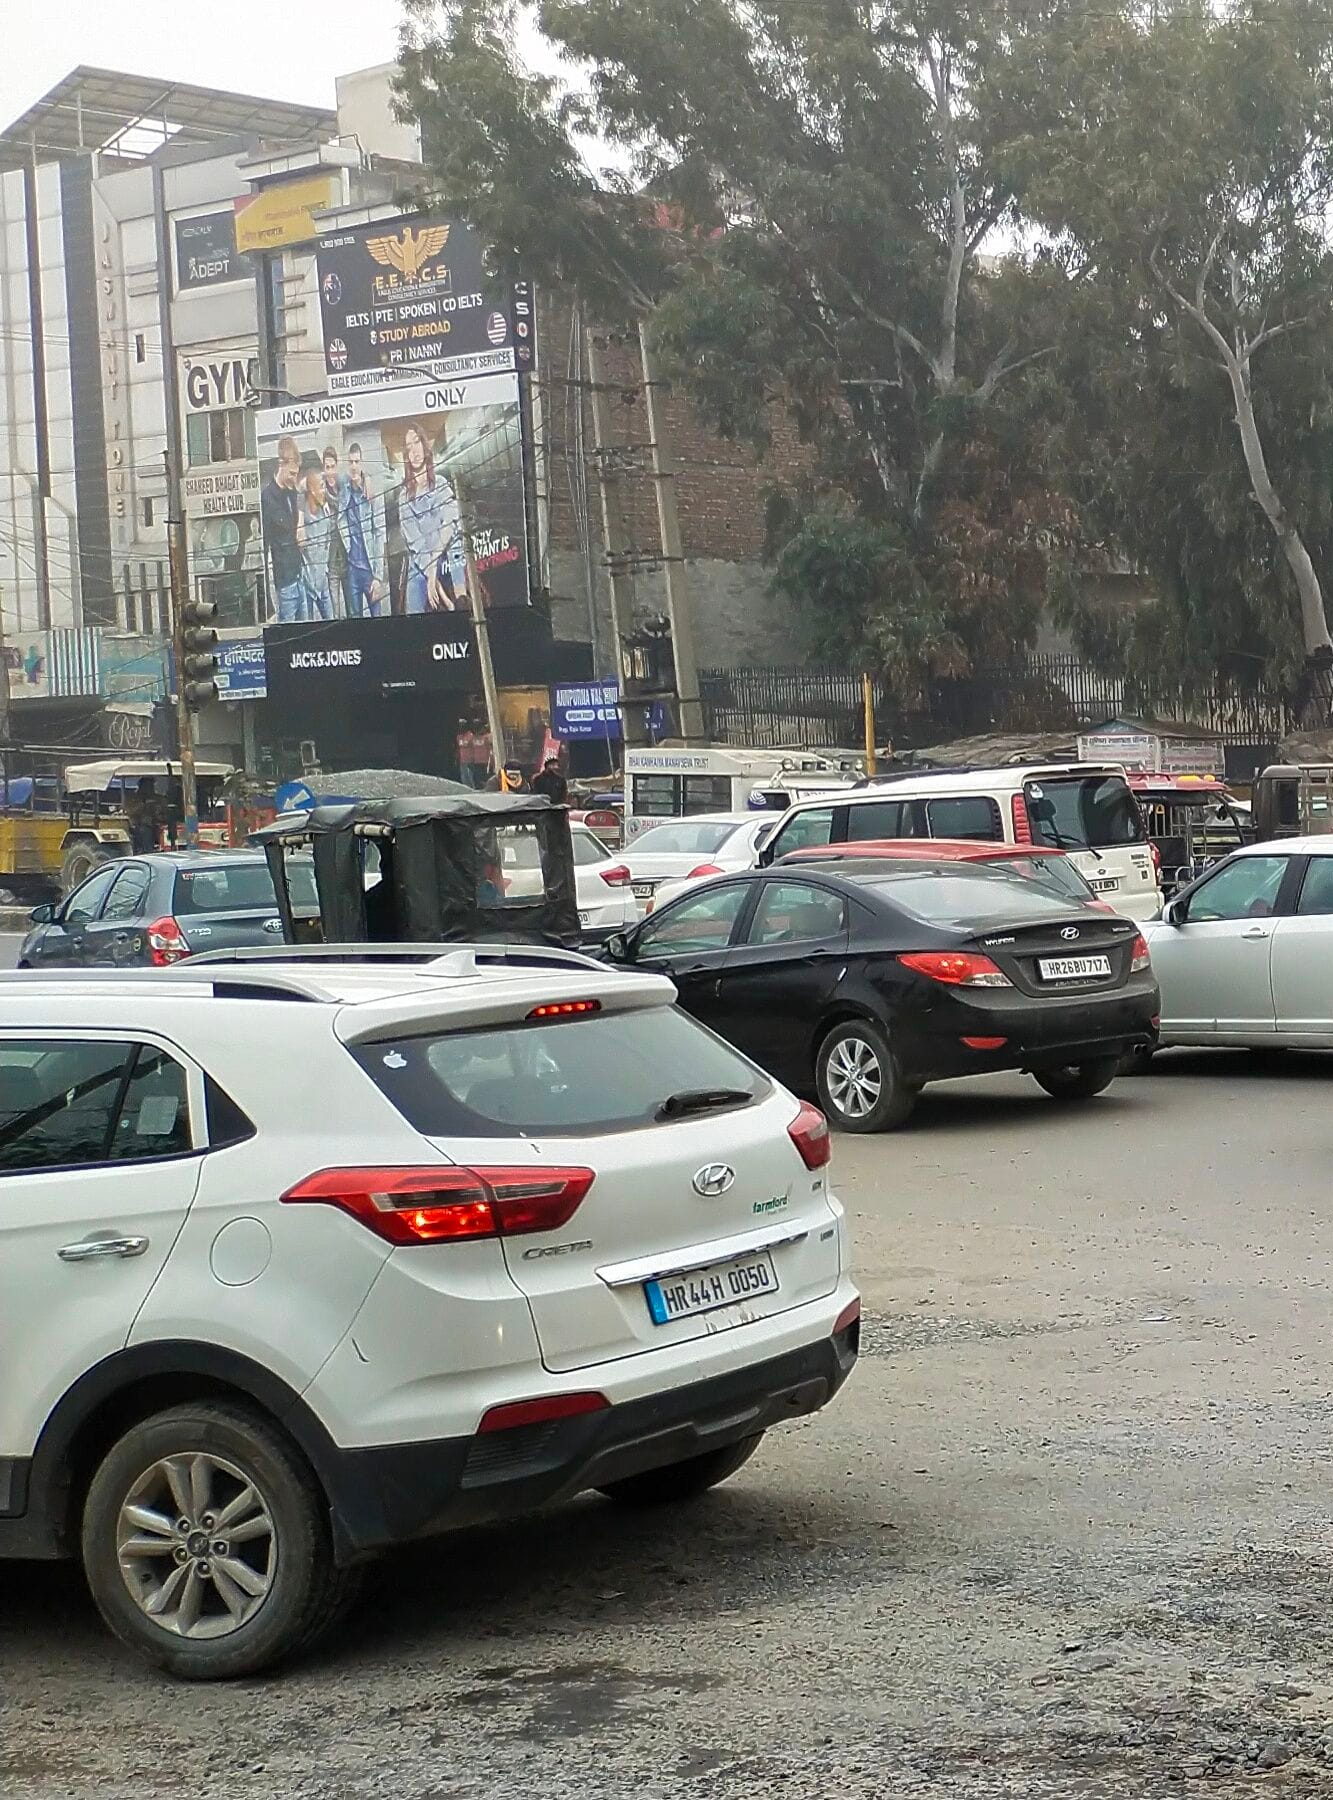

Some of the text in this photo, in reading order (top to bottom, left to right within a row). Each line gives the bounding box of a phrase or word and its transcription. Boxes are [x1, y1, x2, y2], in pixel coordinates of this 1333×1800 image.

[189, 260, 230, 281] ADEPT
[345, 294, 483, 328] IELTS PTE SPOKEN CD IELTS
[379, 328, 409, 343] STUDY
[411, 321, 451, 338] ABROAD
[390, 342, 443, 364] PR NANNY
[331, 375, 350, 390] EAGLE
[350, 371, 383, 388] EDUCATION
[434, 357, 478, 375] CONSULTANCY
[478, 352, 512, 369] SERVICES
[424, 387, 468, 410] ONLY
[280, 403, 354, 429] JACK&JONES
[289, 649, 362, 669] JACK&JONES
[432, 641, 469, 660] ONLY
[521, 1239, 593, 1261] CRETA
[728, 1263, 769, 1296] 0050
